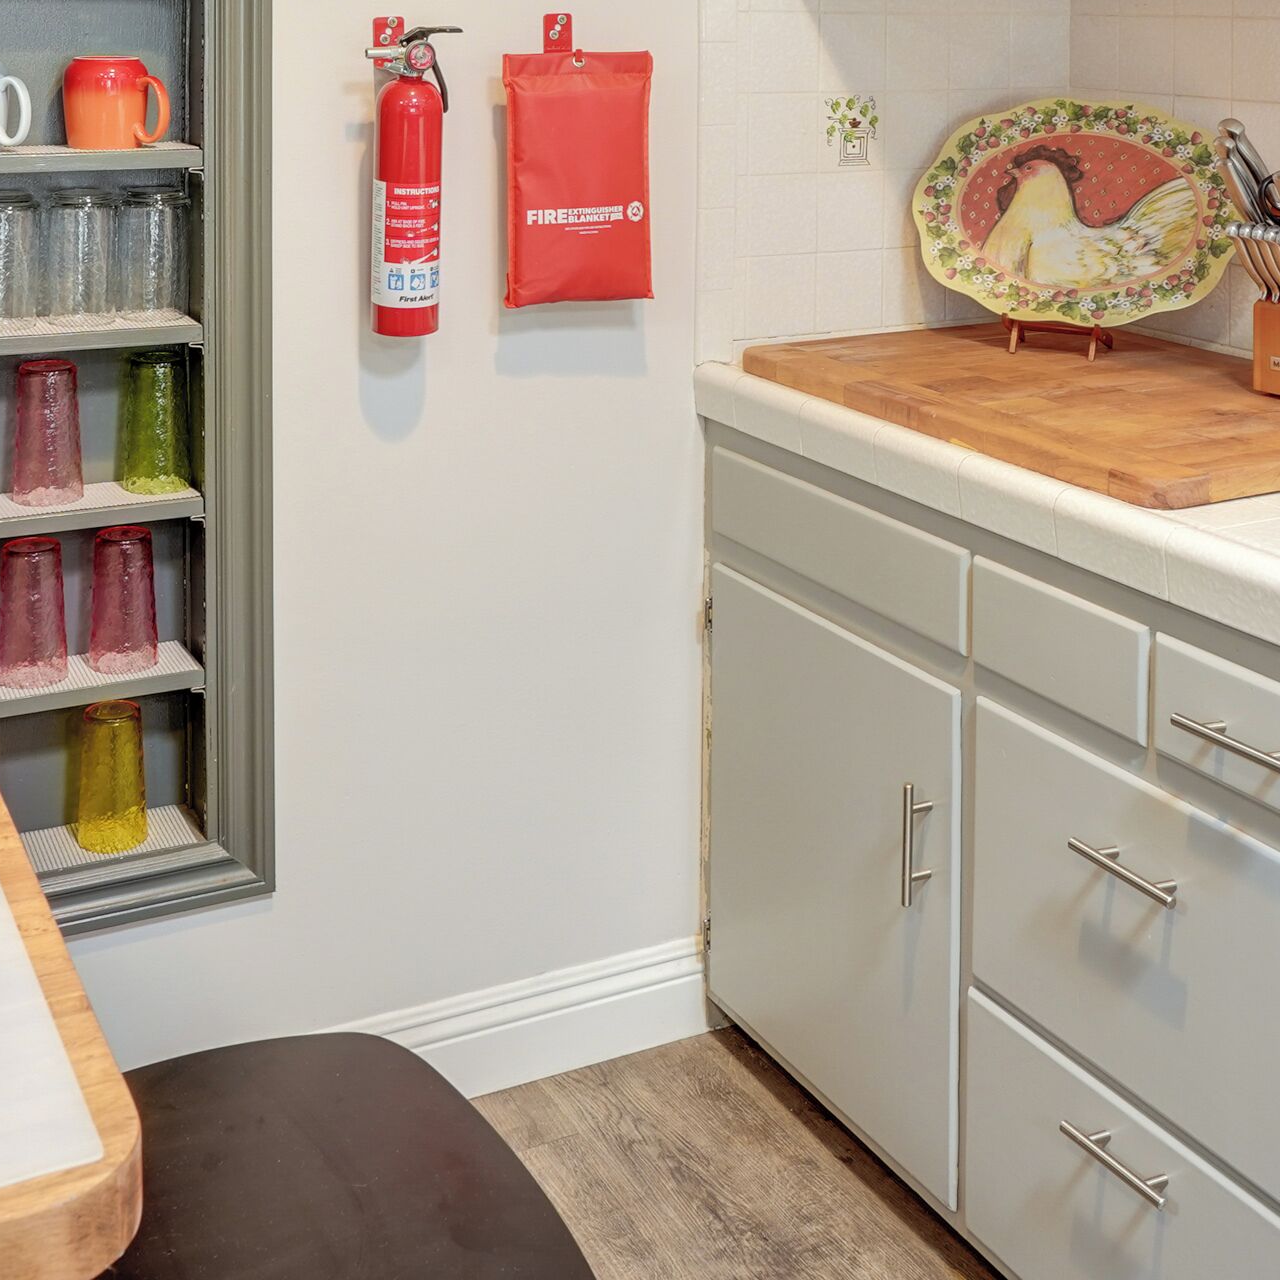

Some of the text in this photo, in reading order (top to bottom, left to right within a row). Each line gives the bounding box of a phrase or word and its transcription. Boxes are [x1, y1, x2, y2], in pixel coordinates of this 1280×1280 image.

[526, 205, 624, 225] FIRE EXTINGUISHER
[568, 213, 609, 223] BLANKET
